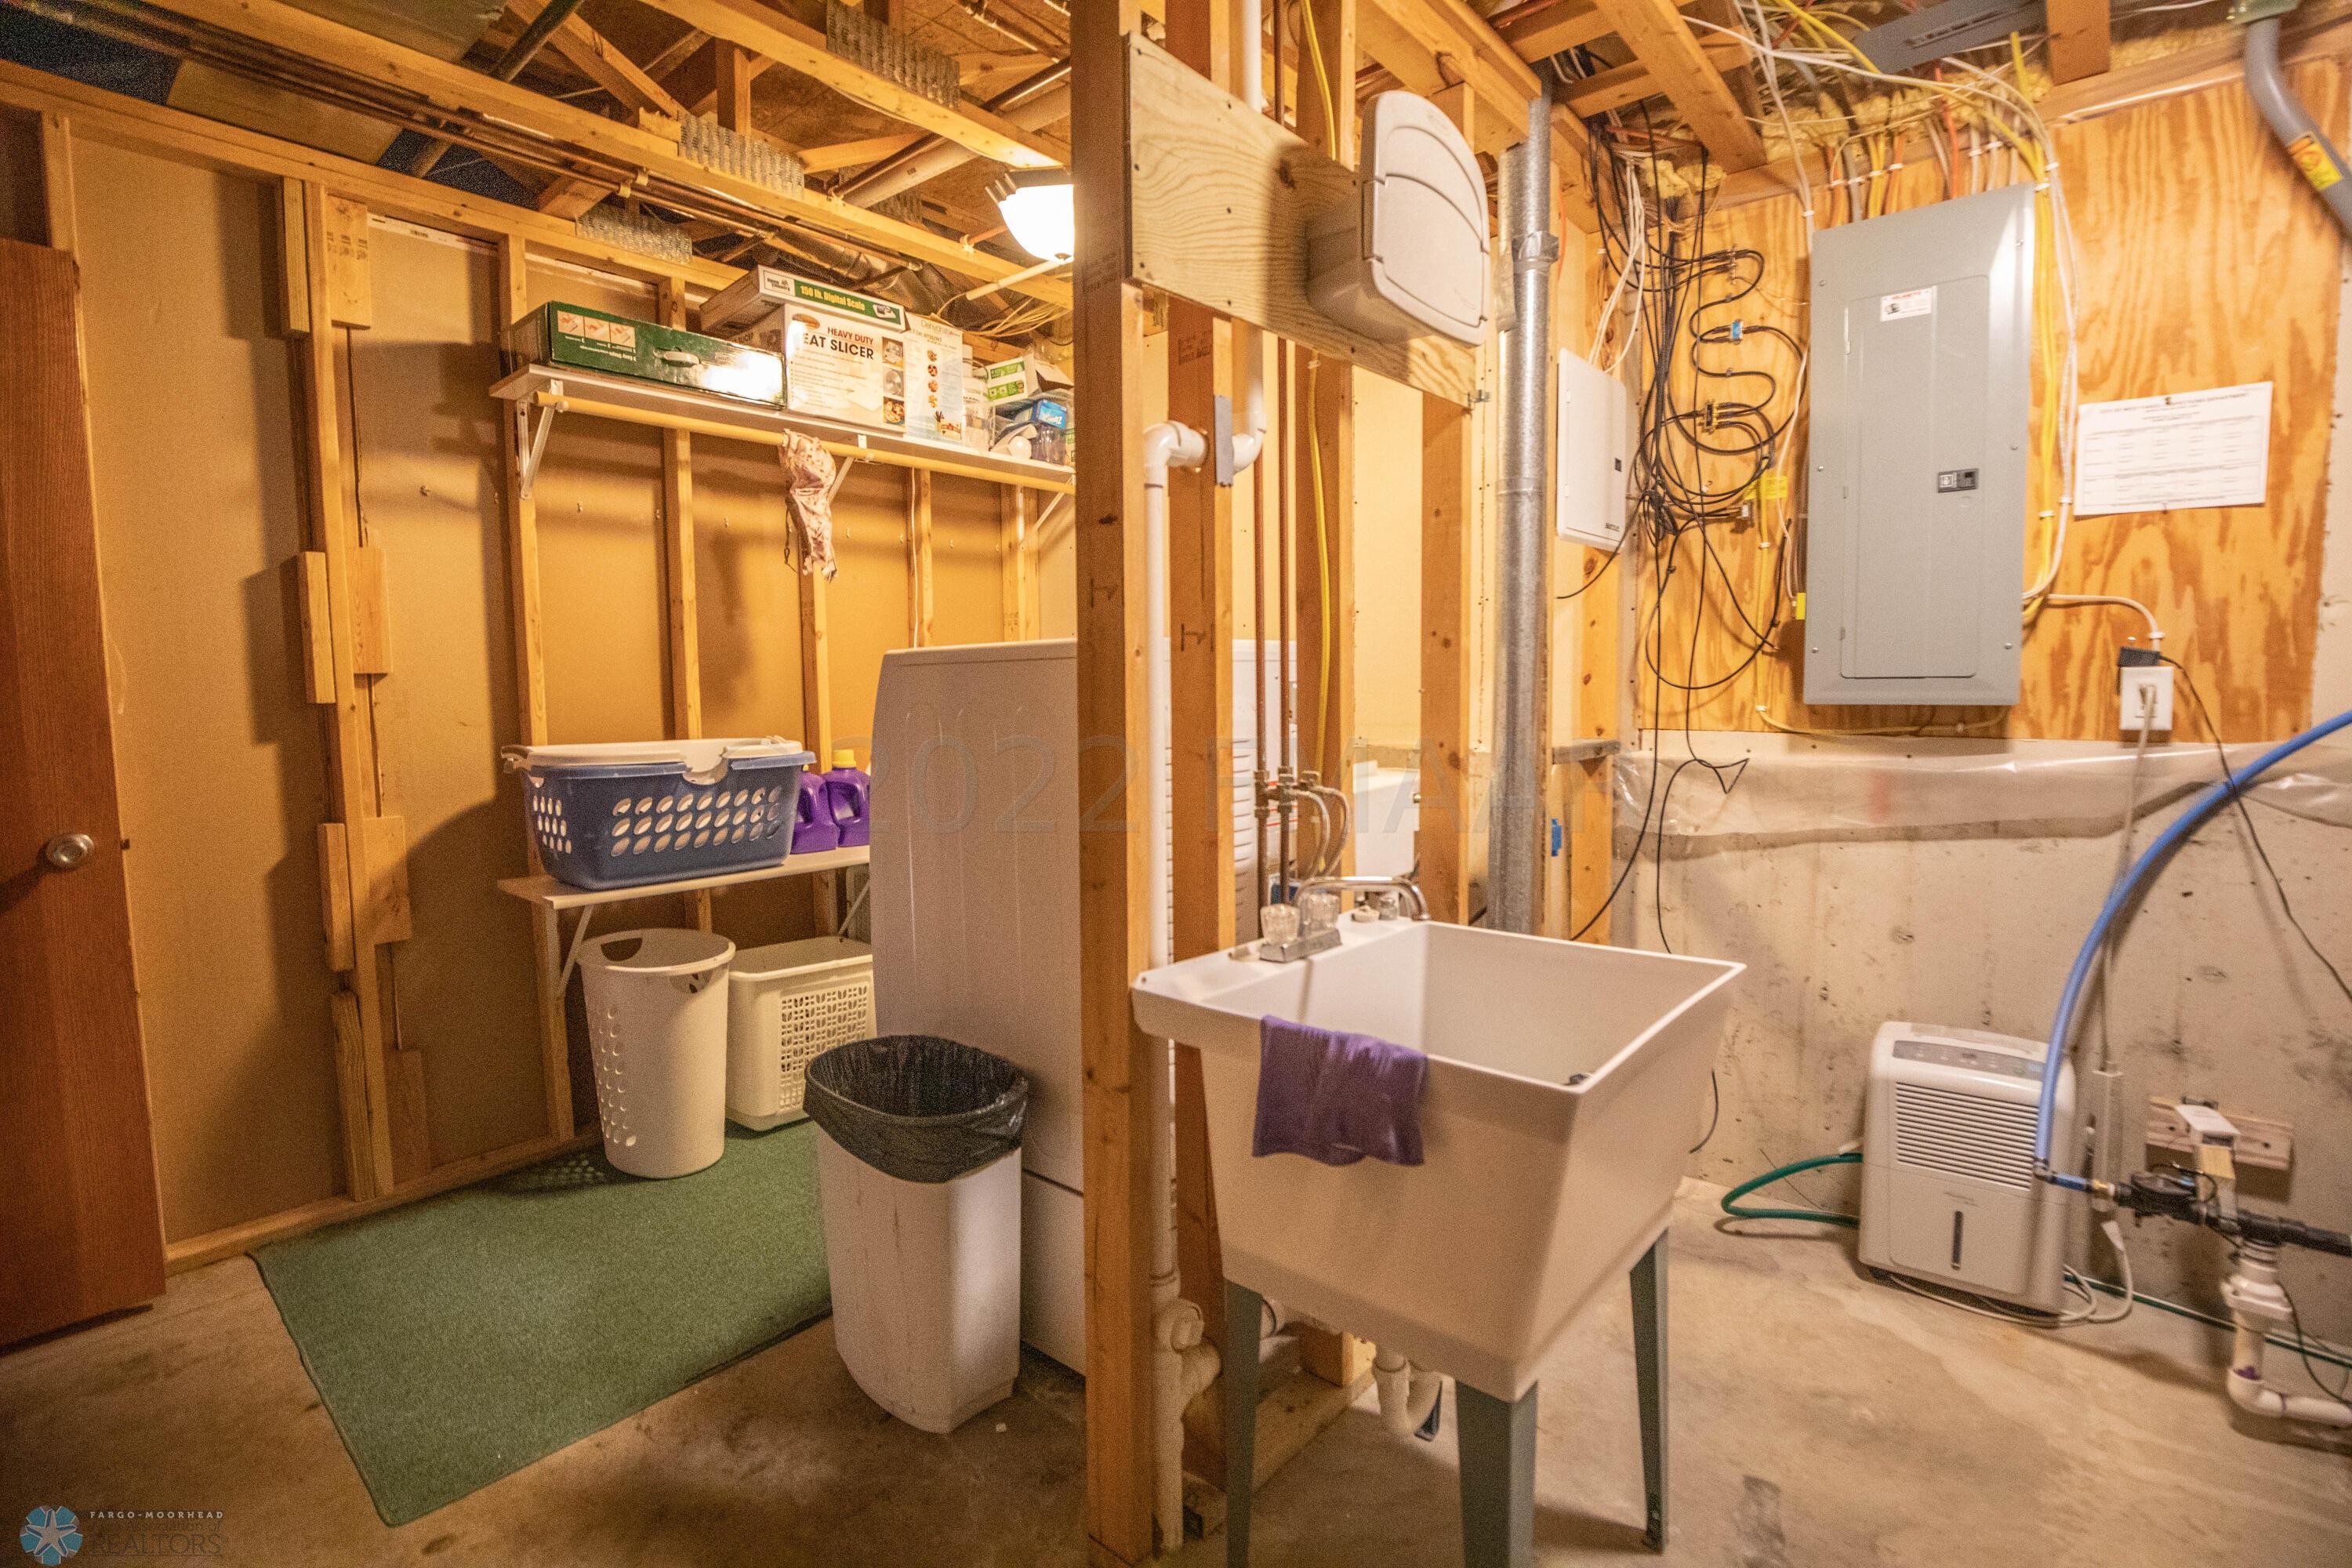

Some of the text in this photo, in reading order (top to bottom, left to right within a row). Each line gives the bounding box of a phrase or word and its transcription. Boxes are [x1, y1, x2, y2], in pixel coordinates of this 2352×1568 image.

[800, 285, 866, 311] 150 lb. Digital Scale
[795, 332, 874, 360] EAT SLICER
[828, 327, 873, 345] HEAVY DUTY
